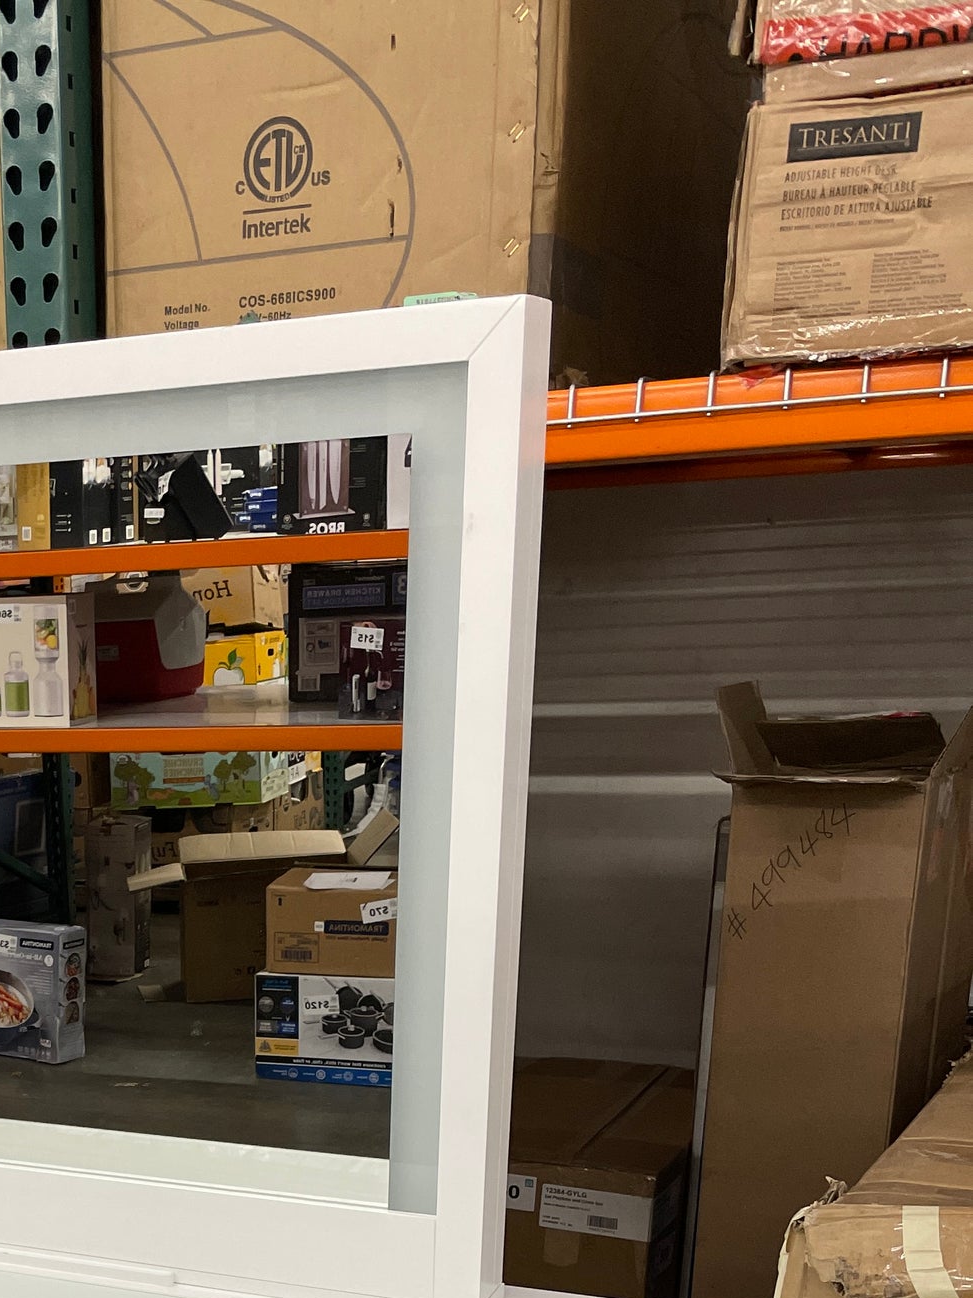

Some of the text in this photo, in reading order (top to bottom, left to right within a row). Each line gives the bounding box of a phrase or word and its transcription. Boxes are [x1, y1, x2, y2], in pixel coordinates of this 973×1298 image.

[798, 121, 911, 149] TRESANTI
[311, 170, 331, 187] US
[785, 167, 838, 183] ADJUSTABLE
[840, 165, 872, 178] HEIGHT
[782, 188, 817, 202] BUREAU
[829, 184, 869, 198] HAUTEUR
[781, 196, 933, 221] ESCRITORIO DE ALTURA AJUSTABLE
[242, 213, 312, 239] Intertek
[164, 287, 336, 316] Model No. COS-668ICS900
[164, 320, 200, 331] Voltage
